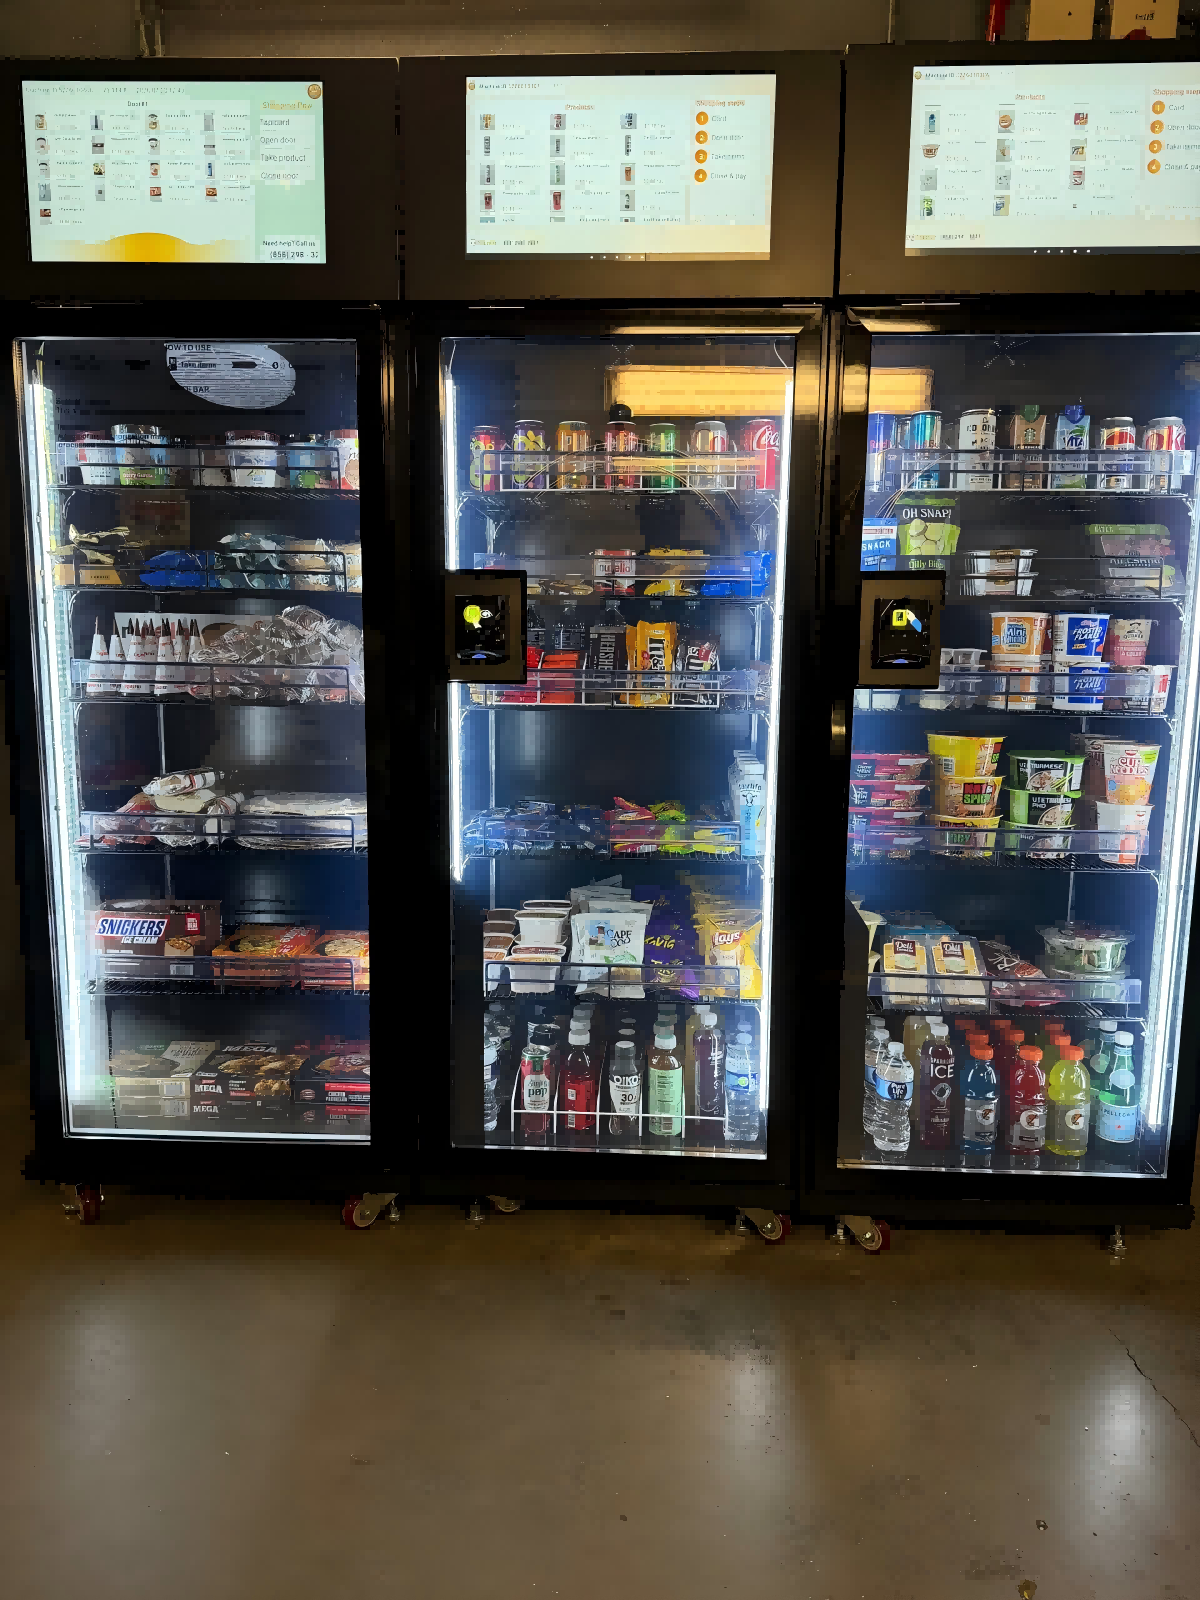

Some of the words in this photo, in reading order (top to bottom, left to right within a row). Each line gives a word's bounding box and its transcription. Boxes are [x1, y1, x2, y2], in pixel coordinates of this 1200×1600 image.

[902, 508, 919, 519] OH
[920, 508, 952, 519] SNAP!
[861, 540, 891, 551] SNACK
[97, 918, 167, 936] SNICKERS
[930, 1063, 955, 1079] ICE
[194, 1083, 223, 1093] MEGA
[193, 1104, 220, 1113] MEGA
